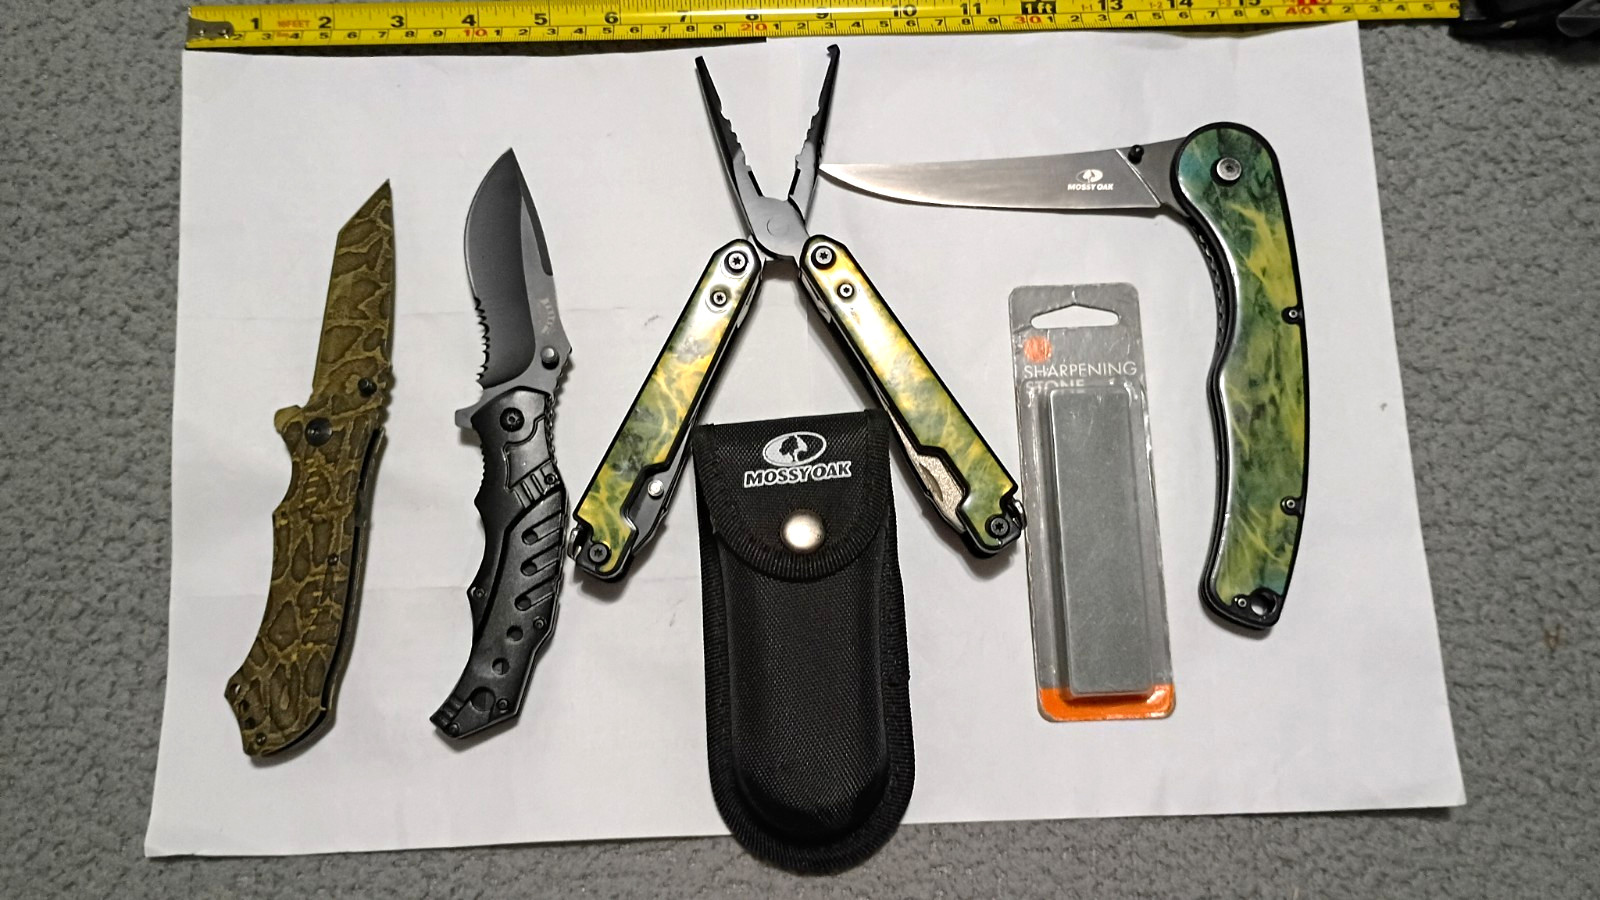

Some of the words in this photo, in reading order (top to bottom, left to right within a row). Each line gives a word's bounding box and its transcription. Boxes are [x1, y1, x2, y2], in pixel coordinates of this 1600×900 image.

[251, 17, 260, 30] 1
[318, 16, 332, 29] 2
[390, 15, 405, 28] 3
[461, 14, 477, 27] 4
[534, 13, 548, 26] 5
[604, 11, 619, 24] 6
[677, 9, 689, 23] 7
[891, 4, 917, 17] 10
[960, 2, 982, 15] 11
[1099, 0, 1123, 11] 13
[347, 31, 357, 39] 6
[404, 30, 415, 38] 8
[463, 29, 488, 37] 10
[519, 28, 528, 36] 2
[713, 24, 723, 32] 9
[740, 23, 767, 31] 20
[797, 22, 806, 30] 2
[1014, 16, 1041, 24] 30
[1098, 14, 1107, 22] 3
[1152, 12, 1162, 20] 5
[1179, 11, 1189, 19] 6
[1207, 10, 1216, 18] 7
[1286, 7, 1313, 15] 40
[1369, 5, 1379, 13] 3
[1423, 3, 1433, 11] 5
[1067, 183, 1097, 191] MOSSY
[1096, 183, 1114, 191] OAK
[1023, 361, 1138, 379] SHARPENING
[743, 465, 812, 488] MOSSY
[811, 461, 852, 481] OAK
